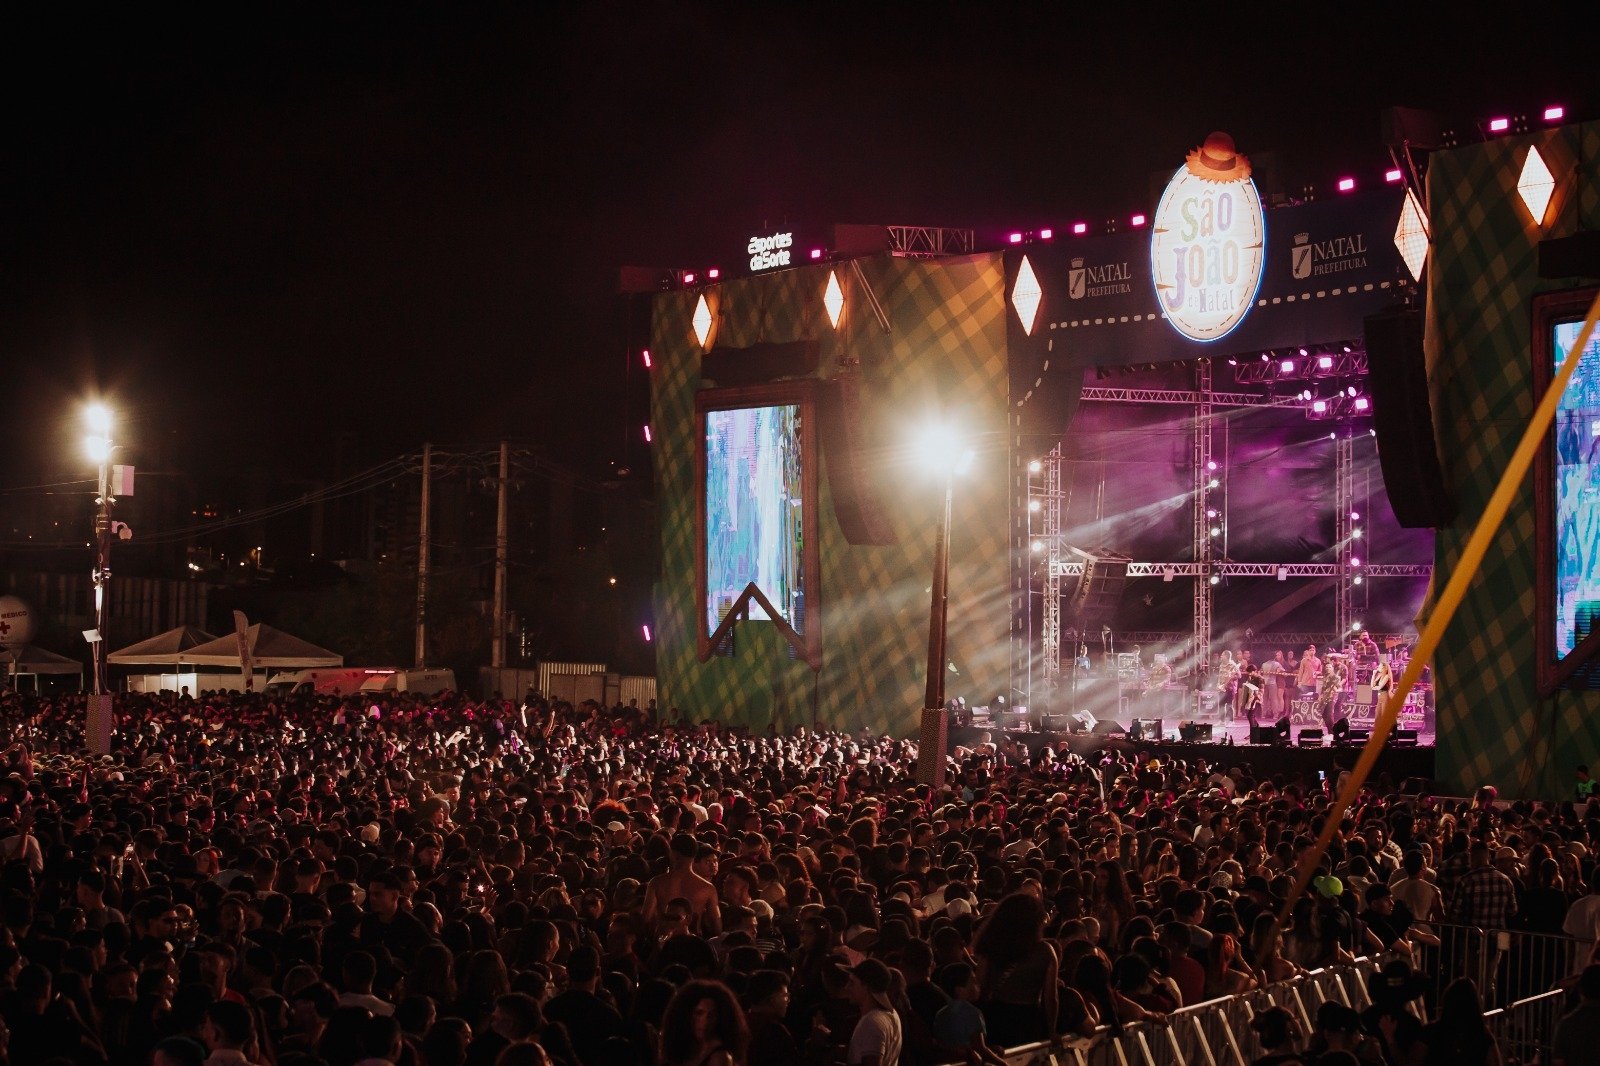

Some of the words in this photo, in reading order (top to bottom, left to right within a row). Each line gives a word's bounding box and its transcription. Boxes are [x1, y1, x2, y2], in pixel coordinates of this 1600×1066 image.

[1313, 234, 1367, 262] NATAL
[1087, 262, 1132, 285] NATAL
[1313, 257, 1367, 276] PREFEITURA
[1087, 283, 1131, 298] PREFEITURA
[1199, 288, 1235, 313] Natal
